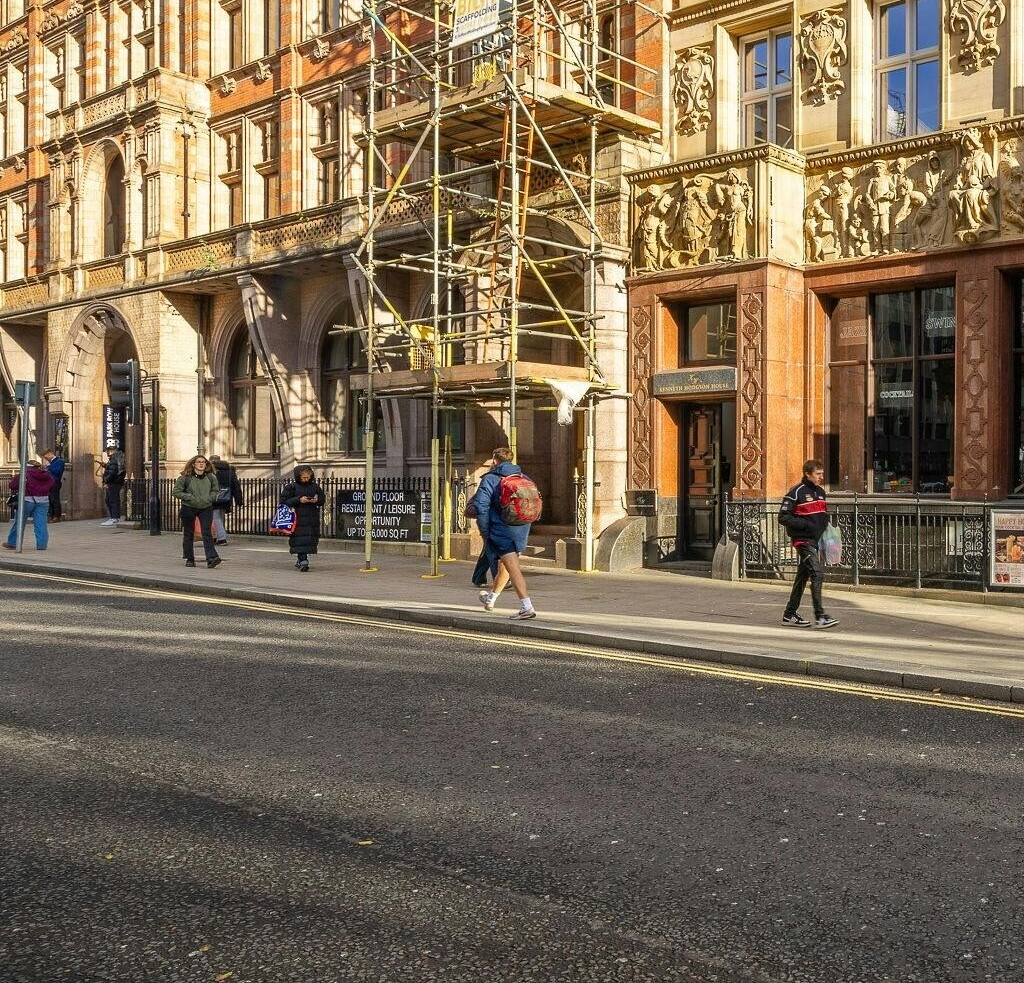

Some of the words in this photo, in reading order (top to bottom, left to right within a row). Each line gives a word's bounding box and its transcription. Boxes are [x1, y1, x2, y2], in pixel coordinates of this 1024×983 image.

[456, 3, 497, 26] SCAFFOLDING
[925, 317, 956, 330] SWIN
[880, 390, 914, 399] COCKTAIL
[106, 421, 114, 438] PARK
[352, 491, 381, 502] GROND
[382, 492, 404, 502] FLOOR
[388, 504, 416, 515] LEISURE
[347, 527, 357, 537] UP
[357, 528, 366, 537] TO
[388, 529, 399, 540] SQ
[400, 529, 409, 538] FT
